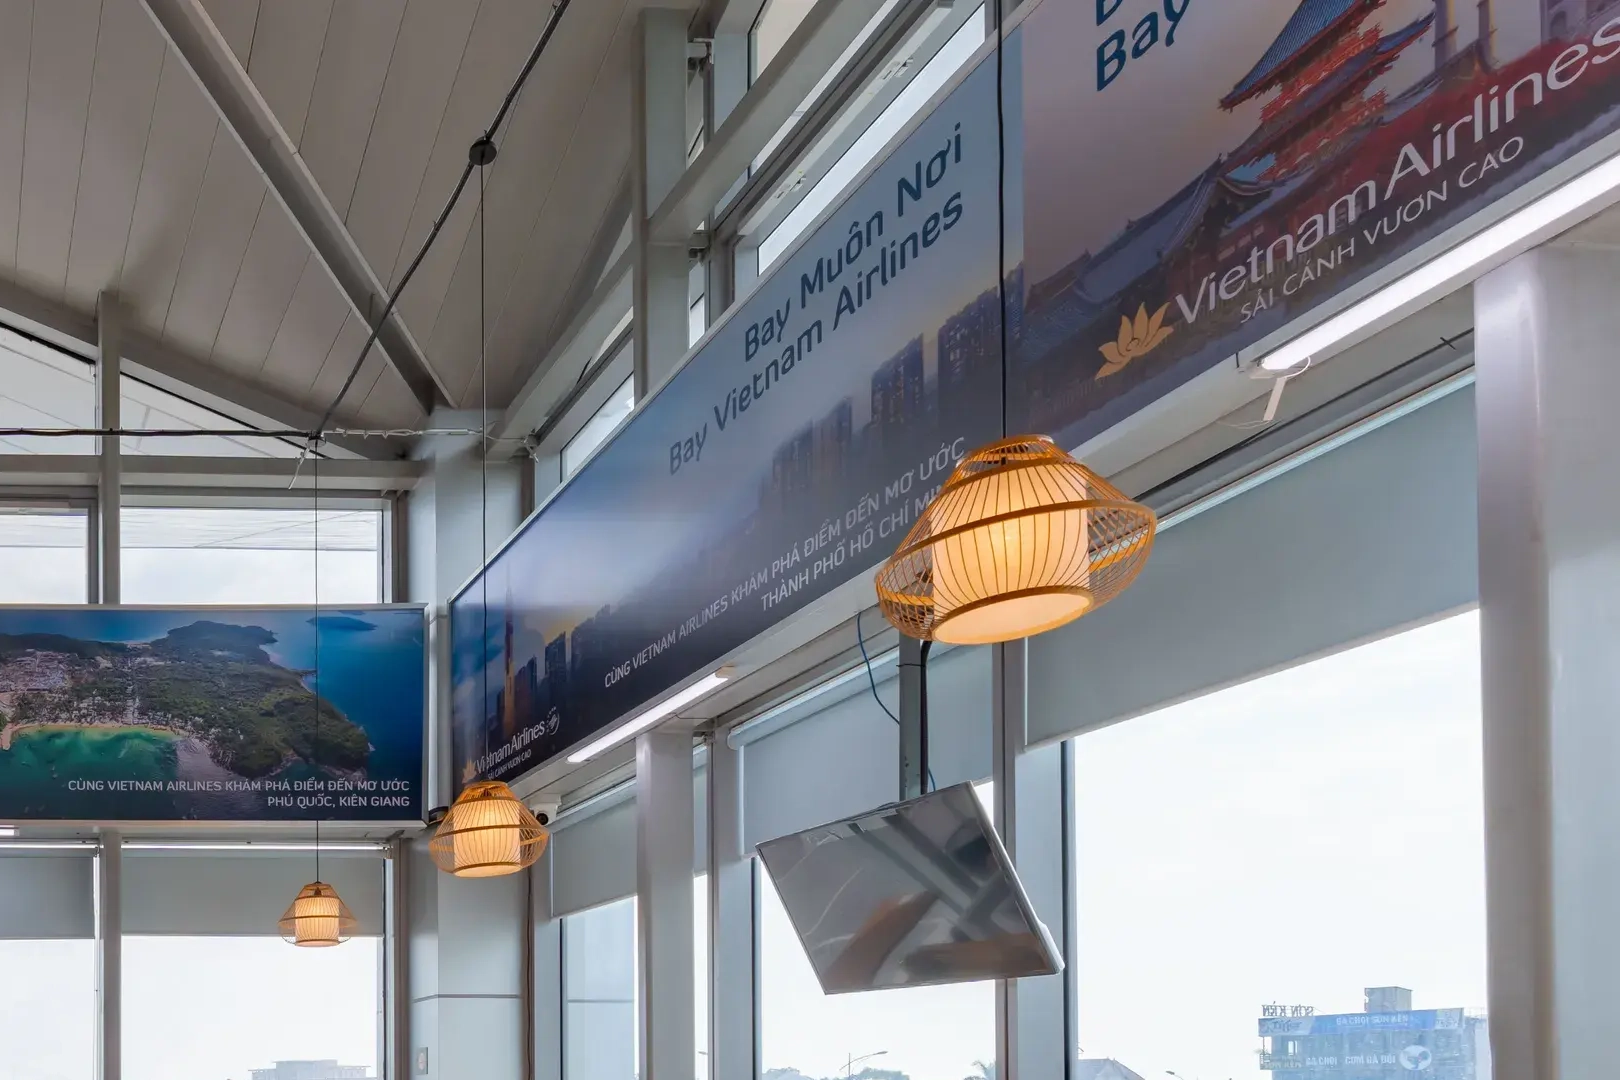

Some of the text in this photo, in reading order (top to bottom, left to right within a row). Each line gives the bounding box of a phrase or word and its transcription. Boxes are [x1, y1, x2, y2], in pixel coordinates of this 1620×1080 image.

[744, 121, 962, 363] Bay Muôn Nơi
[1174, 16, 1620, 326] Vietnam Airlines
[1240, 136, 1524, 324] SẢI CÁNH VƯƠN CAO
[669, 191, 964, 476] Bay Vietnam Airlines
[604, 660, 631, 688] CÙNG
[632, 630, 677, 670] VIETNAM
[679, 594, 728, 641] AIRLINES
[731, 565, 769, 602] KHÁM
[771, 543, 801, 579] PHÁ
[803, 517, 841, 556] ĐIỂM
[845, 495, 879, 531] ĐẾN
[885, 468, 915, 502] MƠ
[919, 436, 966, 480] ƯỚC
[761, 571, 810, 612] THÀNH
[813, 543, 846, 581] PHỐ
[849, 523, 875, 559] HỒ
[879, 498, 910, 538] CHÍ
[68, 776, 410, 792] CÙNG VIETNAM AIRLINES KHÁM PHÁ ĐIỂM ĐẾN MƠ ƯỚC
[267, 794, 293, 807] PHÚ
[339, 793, 368, 807] KIÊN
[370, 796, 410, 807] GIANG
